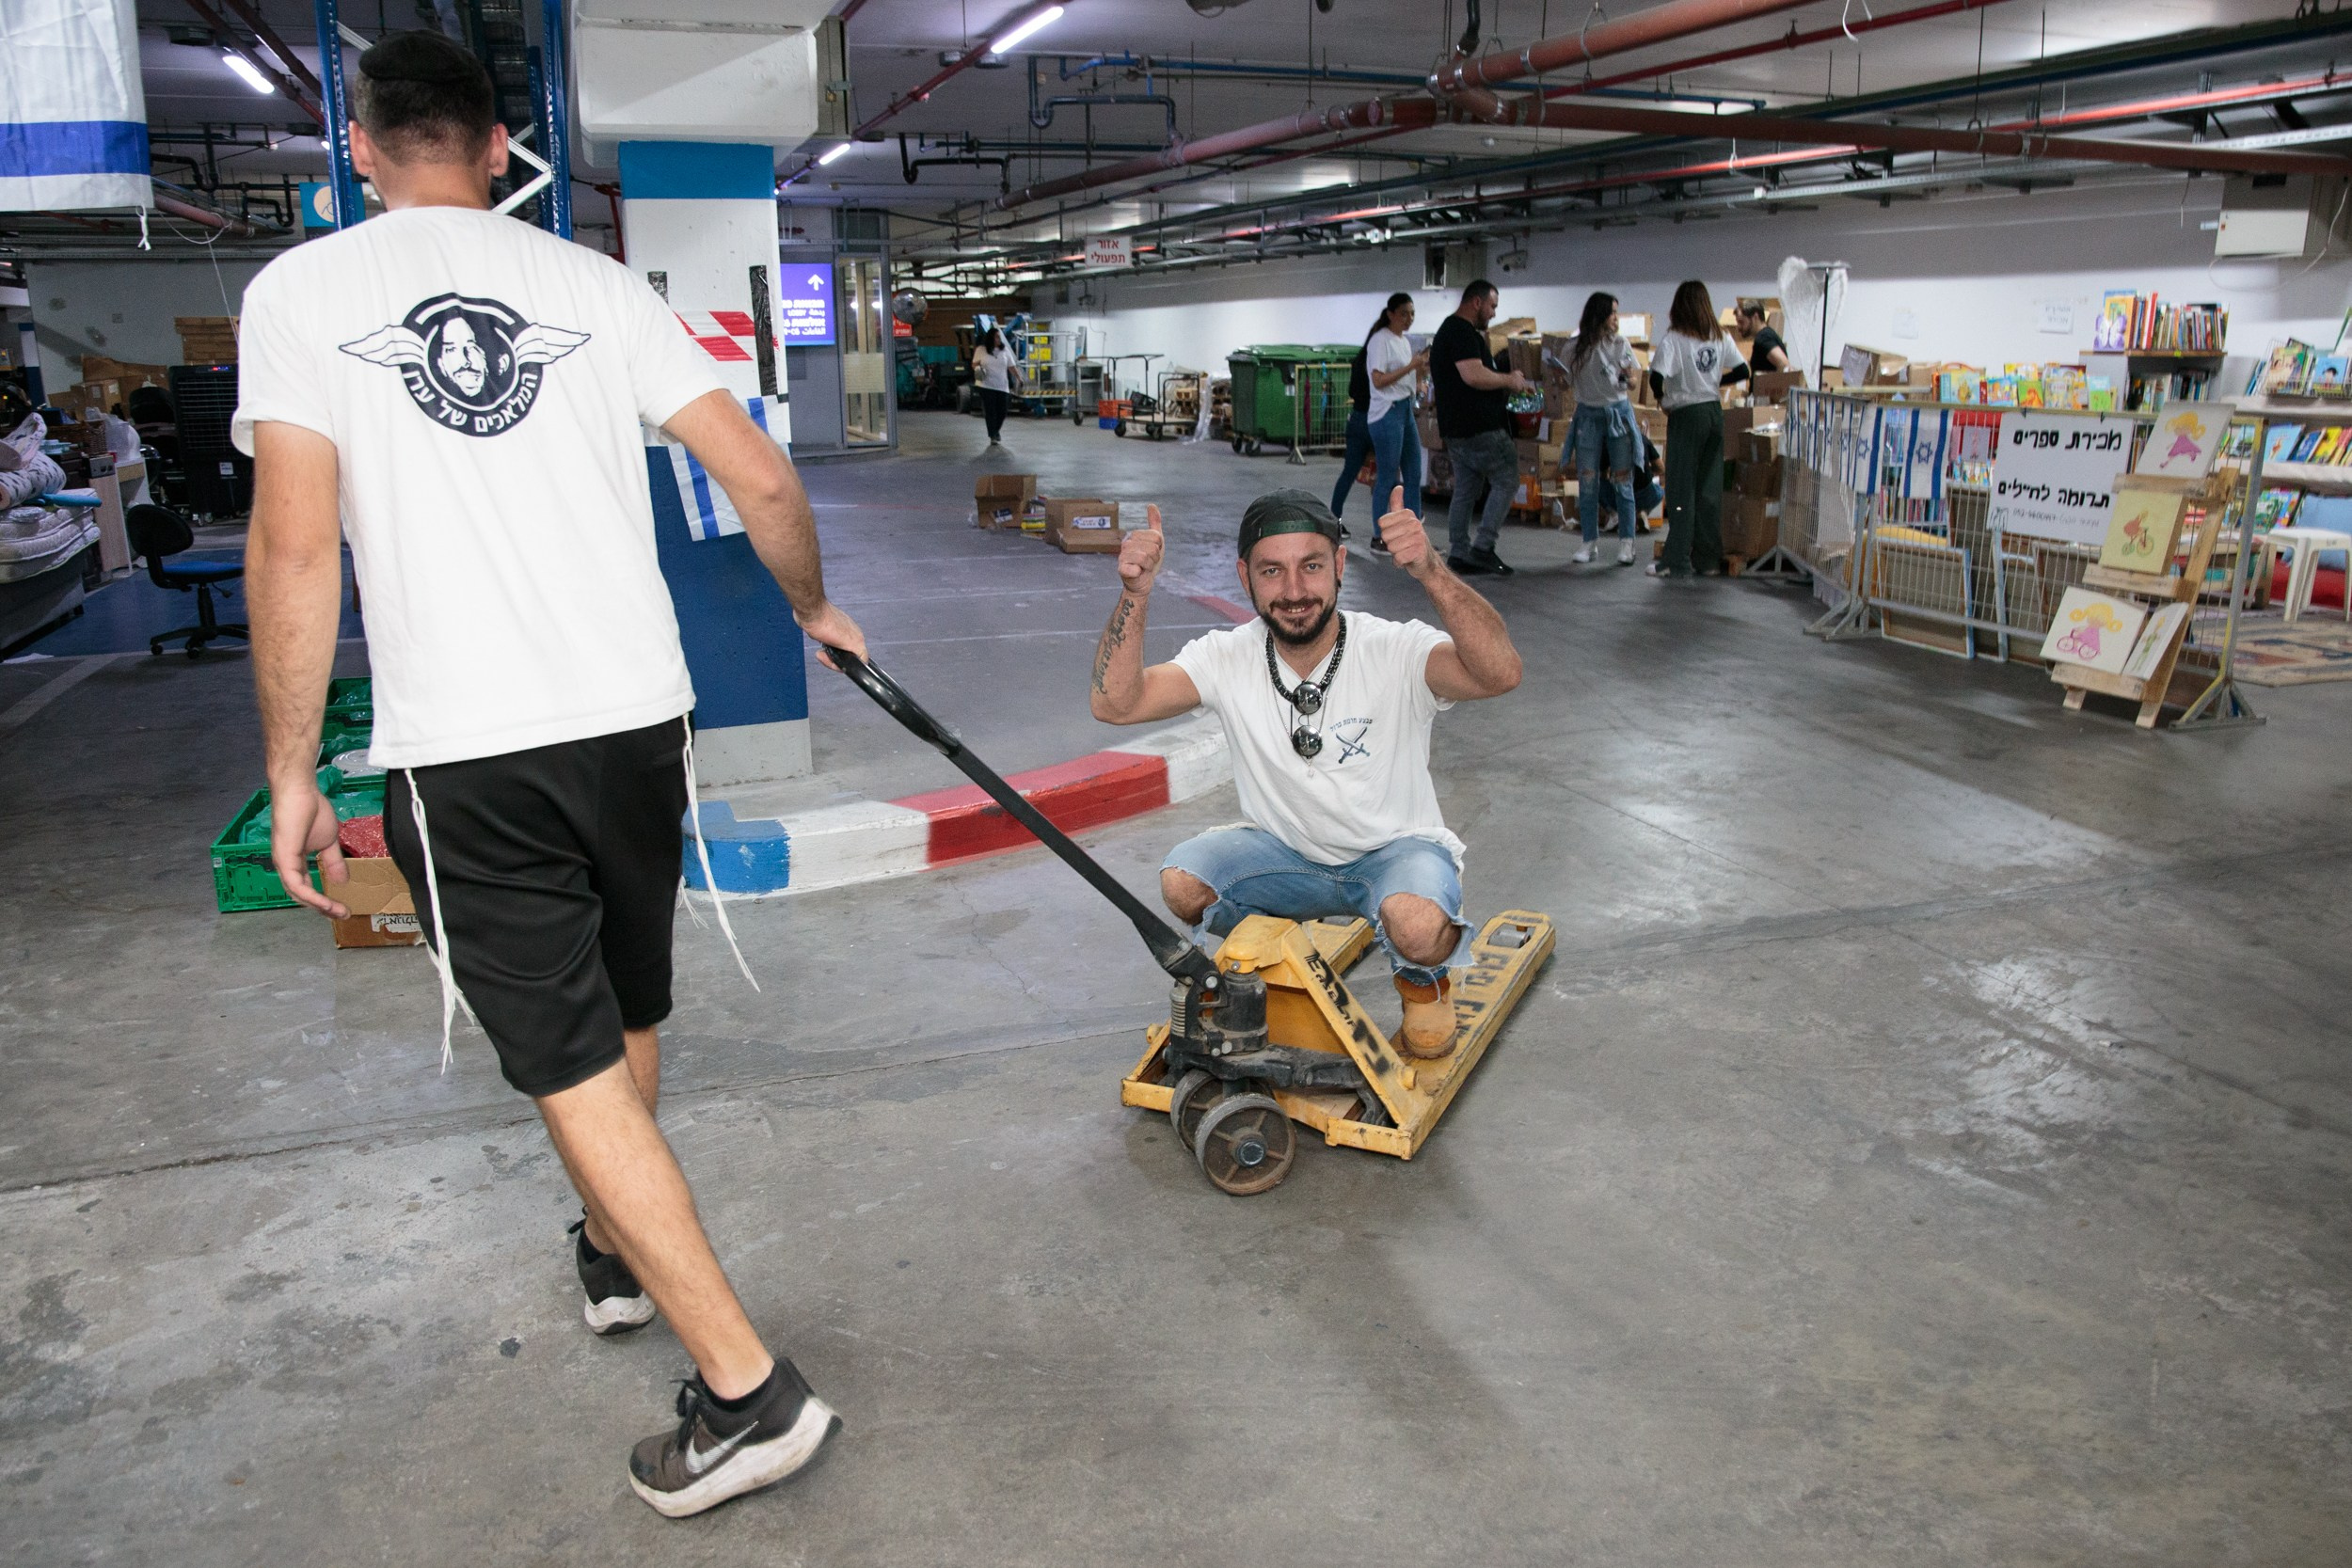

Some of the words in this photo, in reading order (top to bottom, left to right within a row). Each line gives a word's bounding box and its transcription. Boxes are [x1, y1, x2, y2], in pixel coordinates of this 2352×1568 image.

[1097, 239, 1120, 249] אזור
[1090, 251, 1126, 263] תפעולי
[403, 371, 436, 404] ערן
[437, 400, 468, 426] של
[474, 372, 538, 433] המלאכים
[2013, 429, 2059, 449] ספרים
[2064, 428, 2122, 451] מכירת
[1997, 478, 2051, 501] לחיילים
[2058, 487, 2110, 509] תרומה
[1304, 951, 1359, 1031] EASELIF
